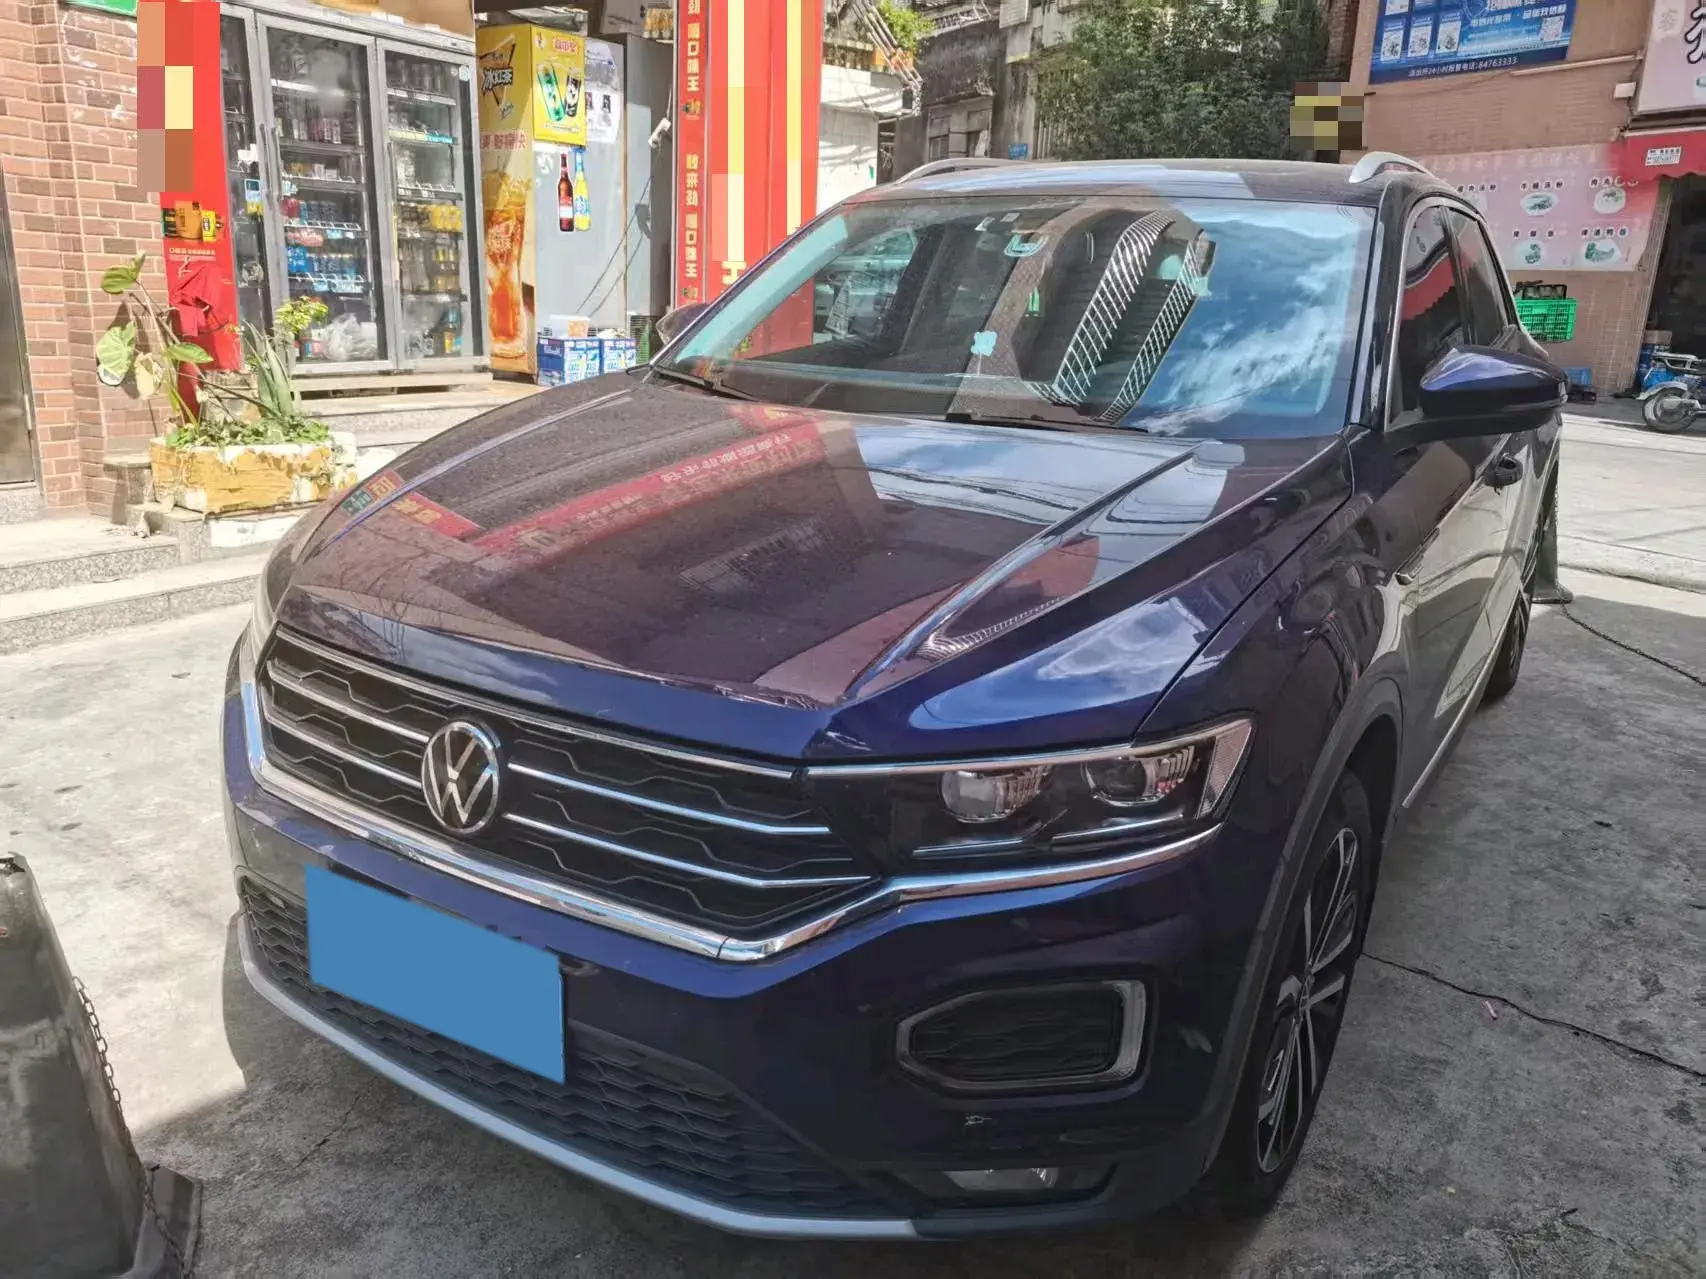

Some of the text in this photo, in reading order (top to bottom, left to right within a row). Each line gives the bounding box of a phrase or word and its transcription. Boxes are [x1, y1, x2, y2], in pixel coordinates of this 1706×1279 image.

[482, 67, 514, 91] 冰红茶
[421, 721, 500, 834] VW
